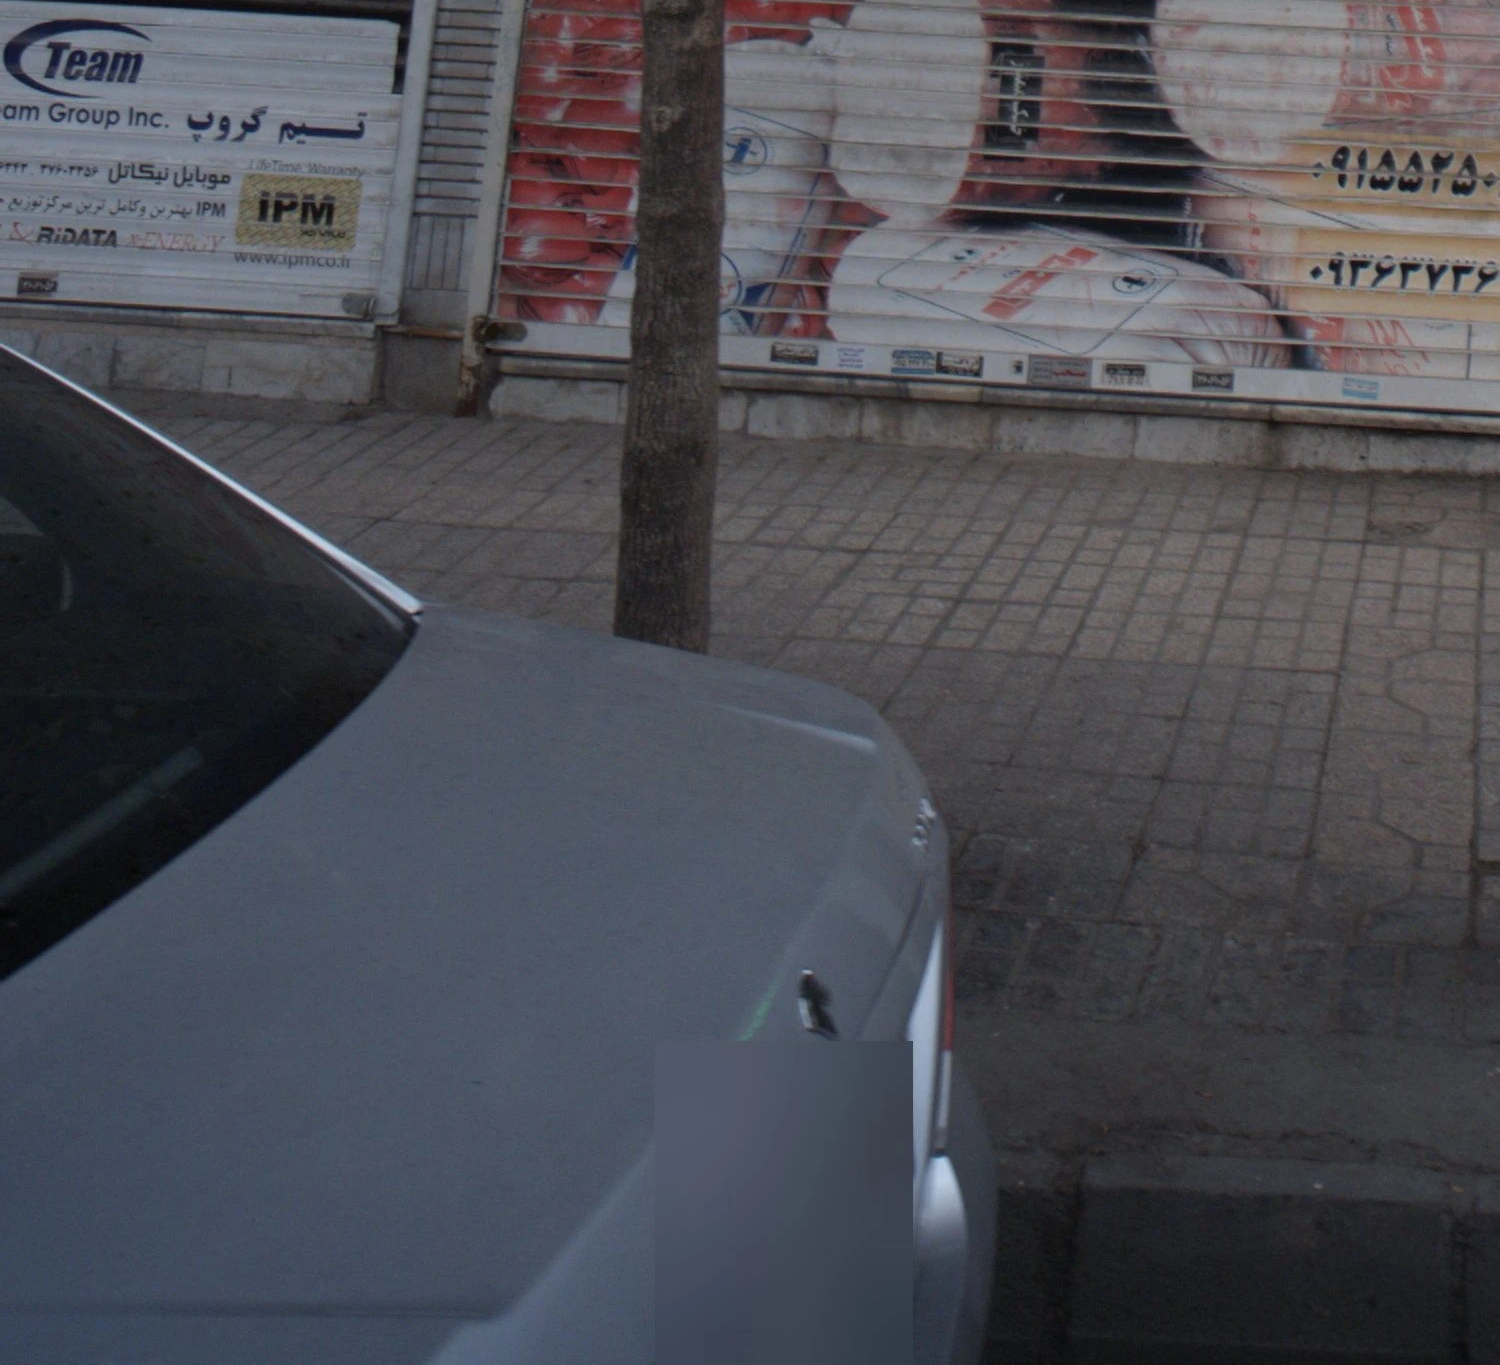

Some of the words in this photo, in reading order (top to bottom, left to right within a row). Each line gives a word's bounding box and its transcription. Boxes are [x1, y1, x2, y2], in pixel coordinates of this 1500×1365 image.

[44, 41, 144, 84] Team
[0, 104, 39, 121] am
[48, 102, 120, 130] Group
[128, 106, 169, 129] Inc.
[187, 105, 269, 143] گروپ
[173, 164, 231, 190] موبایل
[76, 199, 106, 215] ترین
[150, 203, 193, 218] بهترین
[196, 201, 225, 217] IPM
